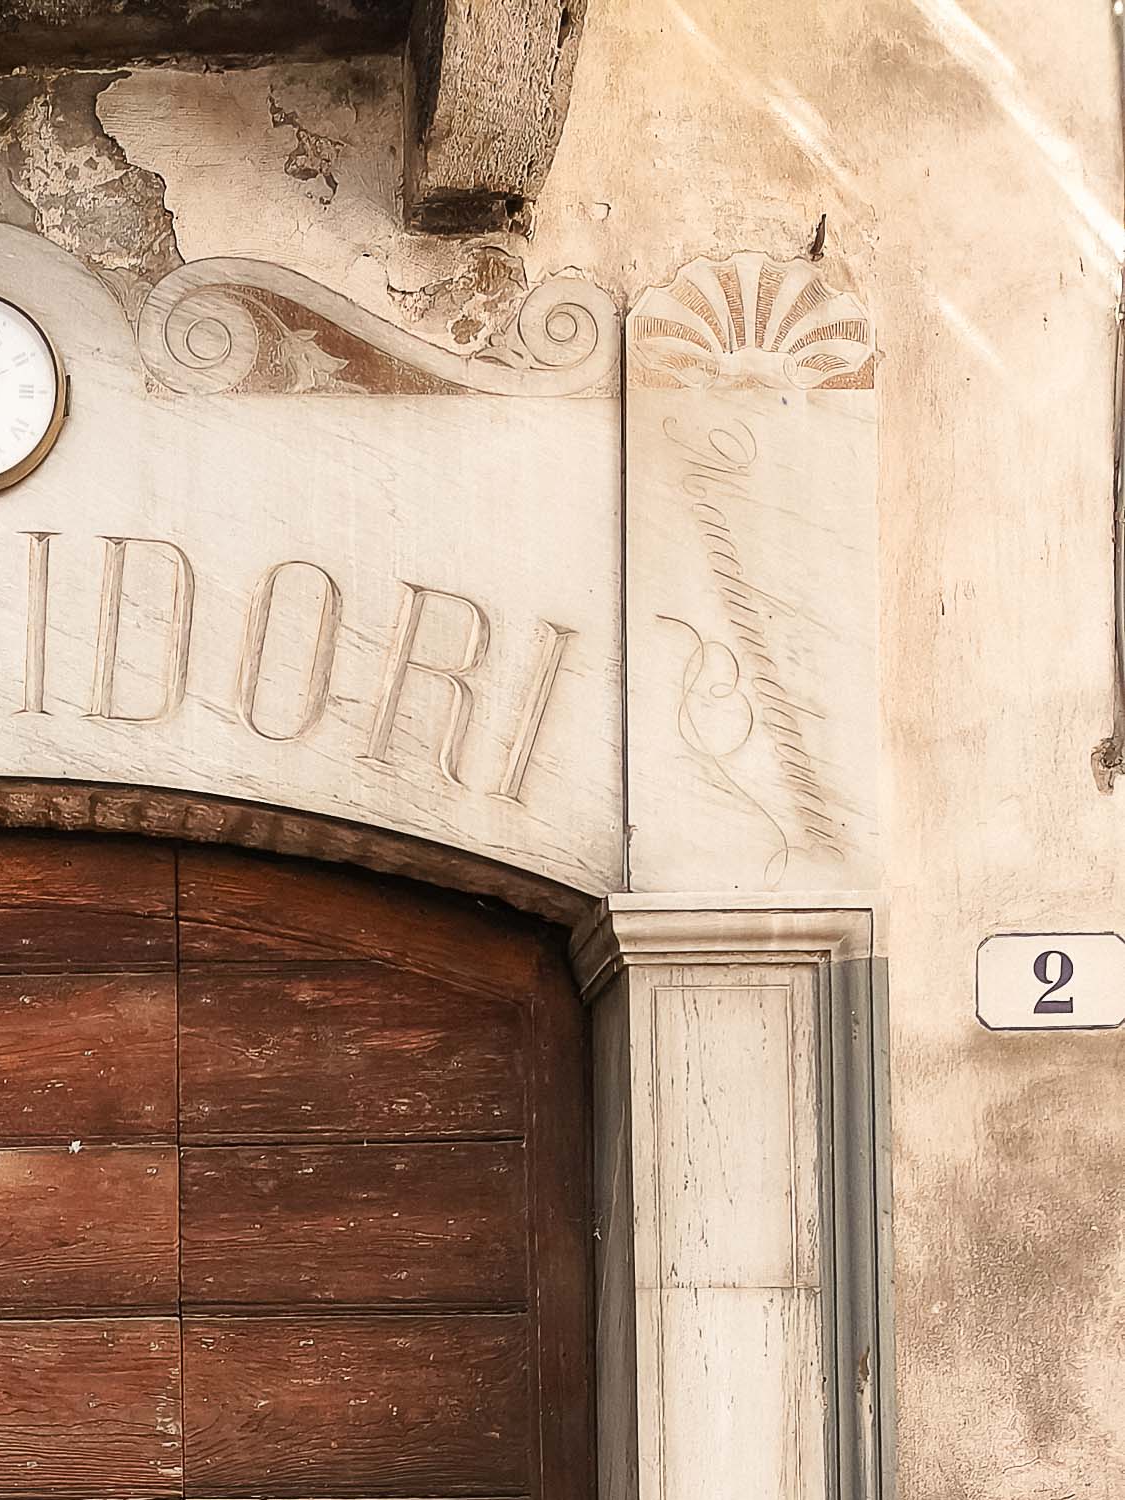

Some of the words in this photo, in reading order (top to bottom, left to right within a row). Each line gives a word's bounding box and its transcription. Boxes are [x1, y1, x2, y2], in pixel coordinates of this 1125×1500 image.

[18, 383, 35, 400] III
[661, 416, 797, 674] Macchine
[1033, 950, 1074, 1014] 2
